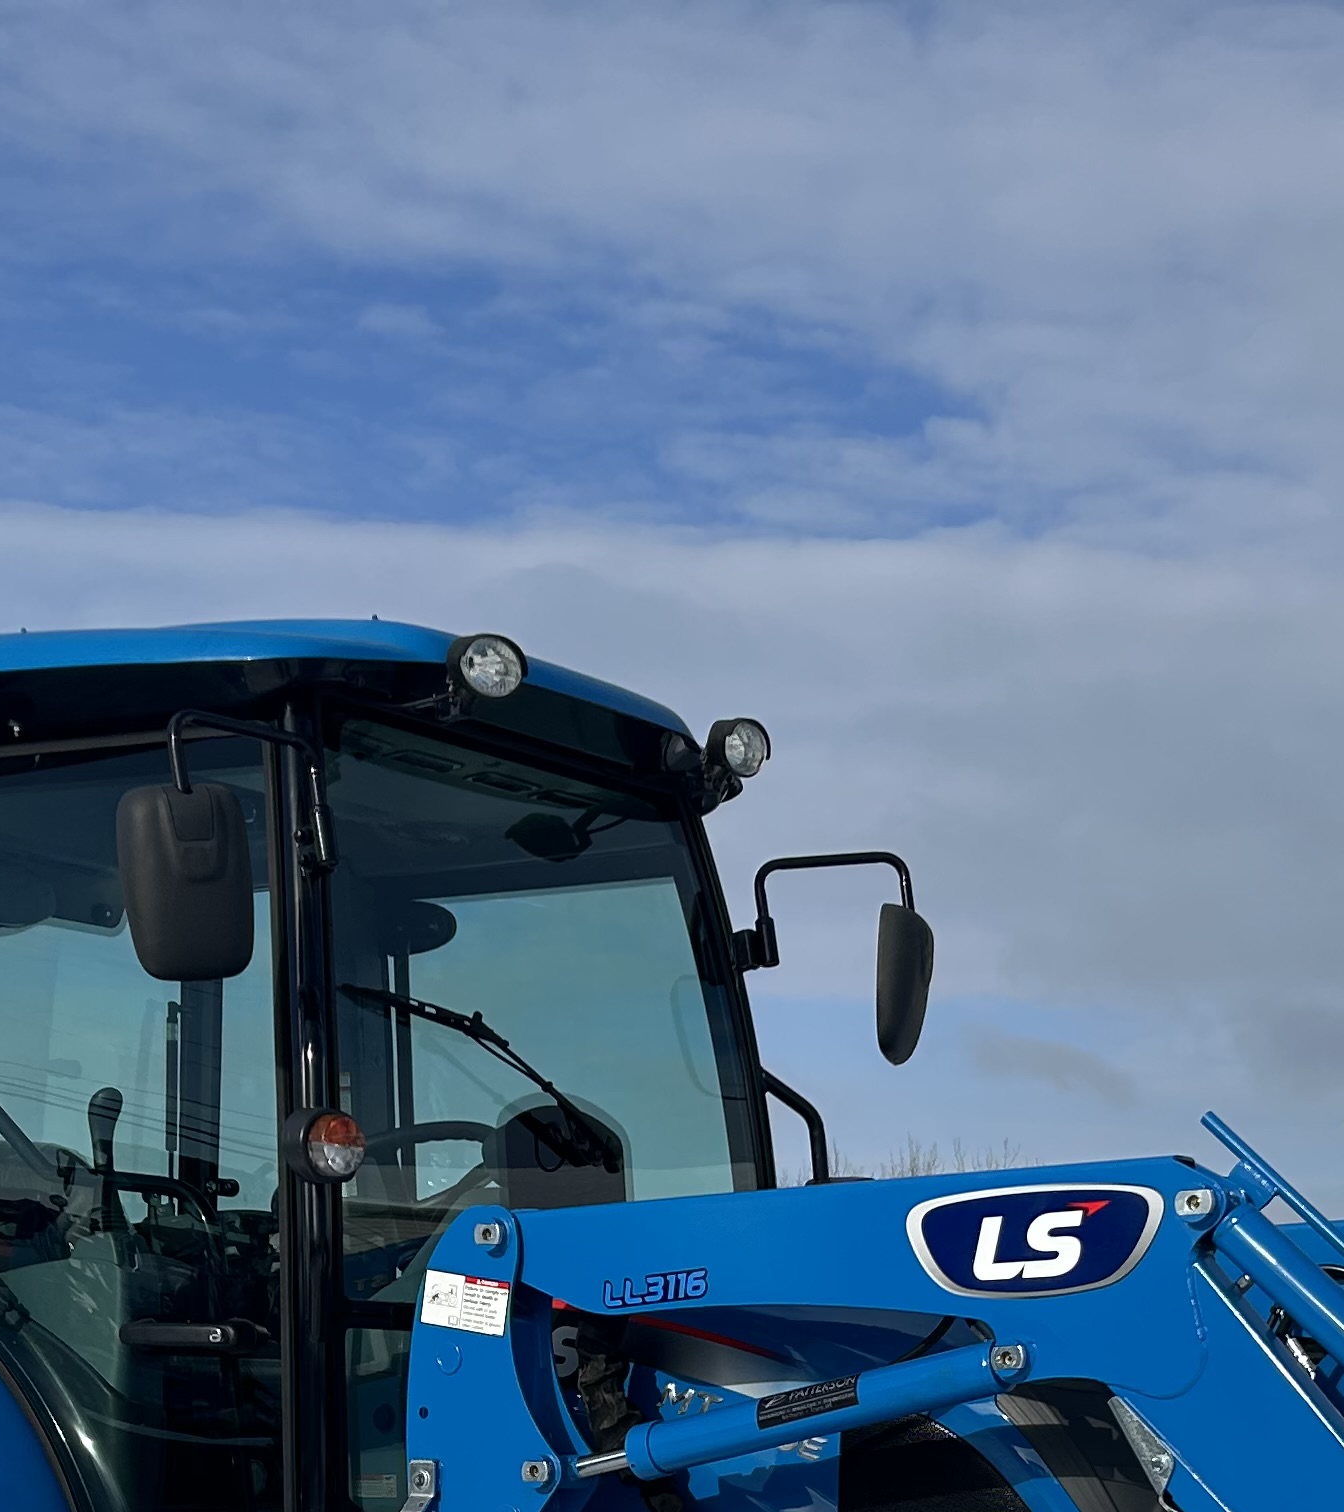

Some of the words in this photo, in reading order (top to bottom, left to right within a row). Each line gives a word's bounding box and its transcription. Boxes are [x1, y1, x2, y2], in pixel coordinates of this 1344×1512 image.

[972, 1209, 1084, 1281] LS
[603, 1269, 707, 1308] LL3116
[552, 1325, 579, 1378] S
[788, 1375, 856, 1401] PATTERSON
